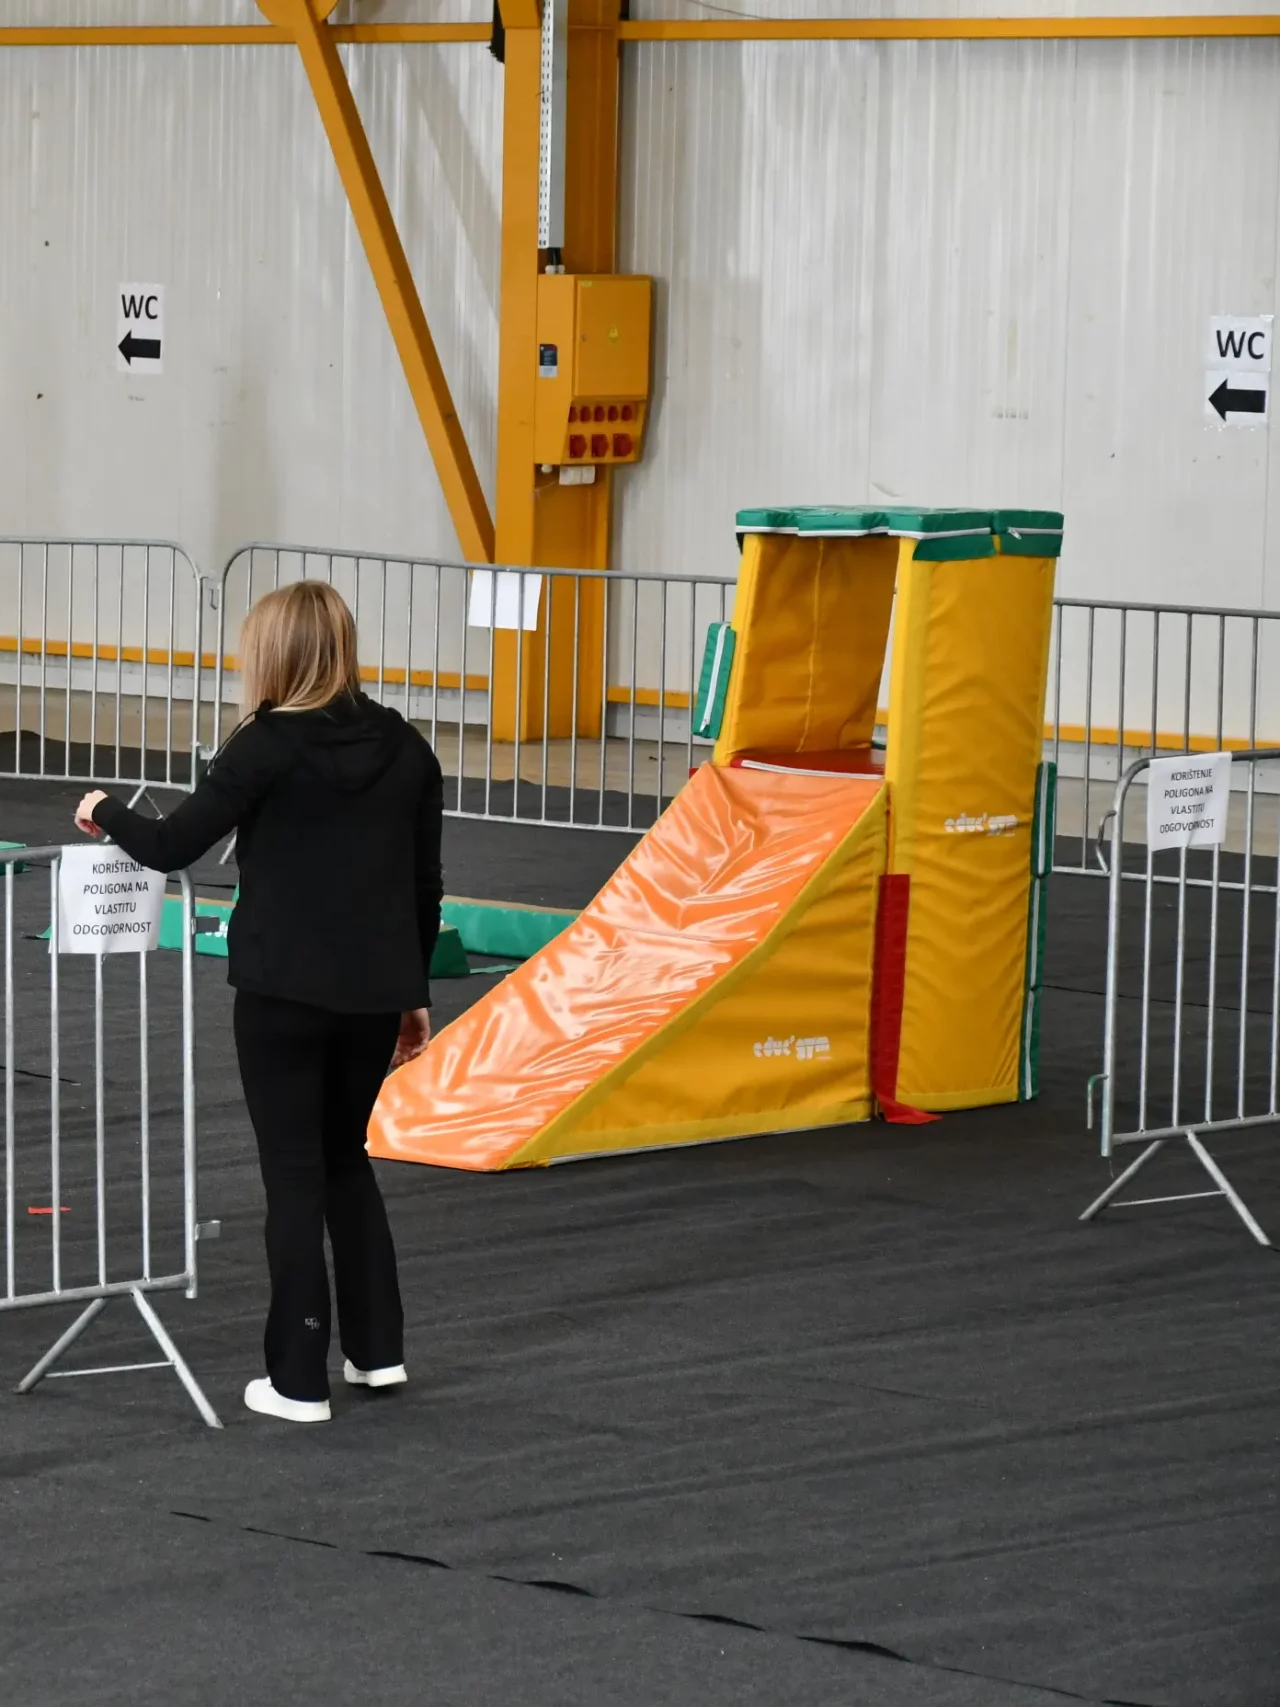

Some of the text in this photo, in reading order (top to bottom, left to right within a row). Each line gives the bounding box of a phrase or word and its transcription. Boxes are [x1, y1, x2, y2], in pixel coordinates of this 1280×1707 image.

[121, 294, 158, 320] WC
[1216, 329, 1265, 360] WC
[1170, 768, 1213, 781] KORIŠTENJE
[1164, 787, 1204, 799] POLIGONA
[83, 881, 149, 895] POLIGONA NA
[94, 902, 137, 915] VLASTITU
[73, 921, 152, 936] ODGOVORNOST
